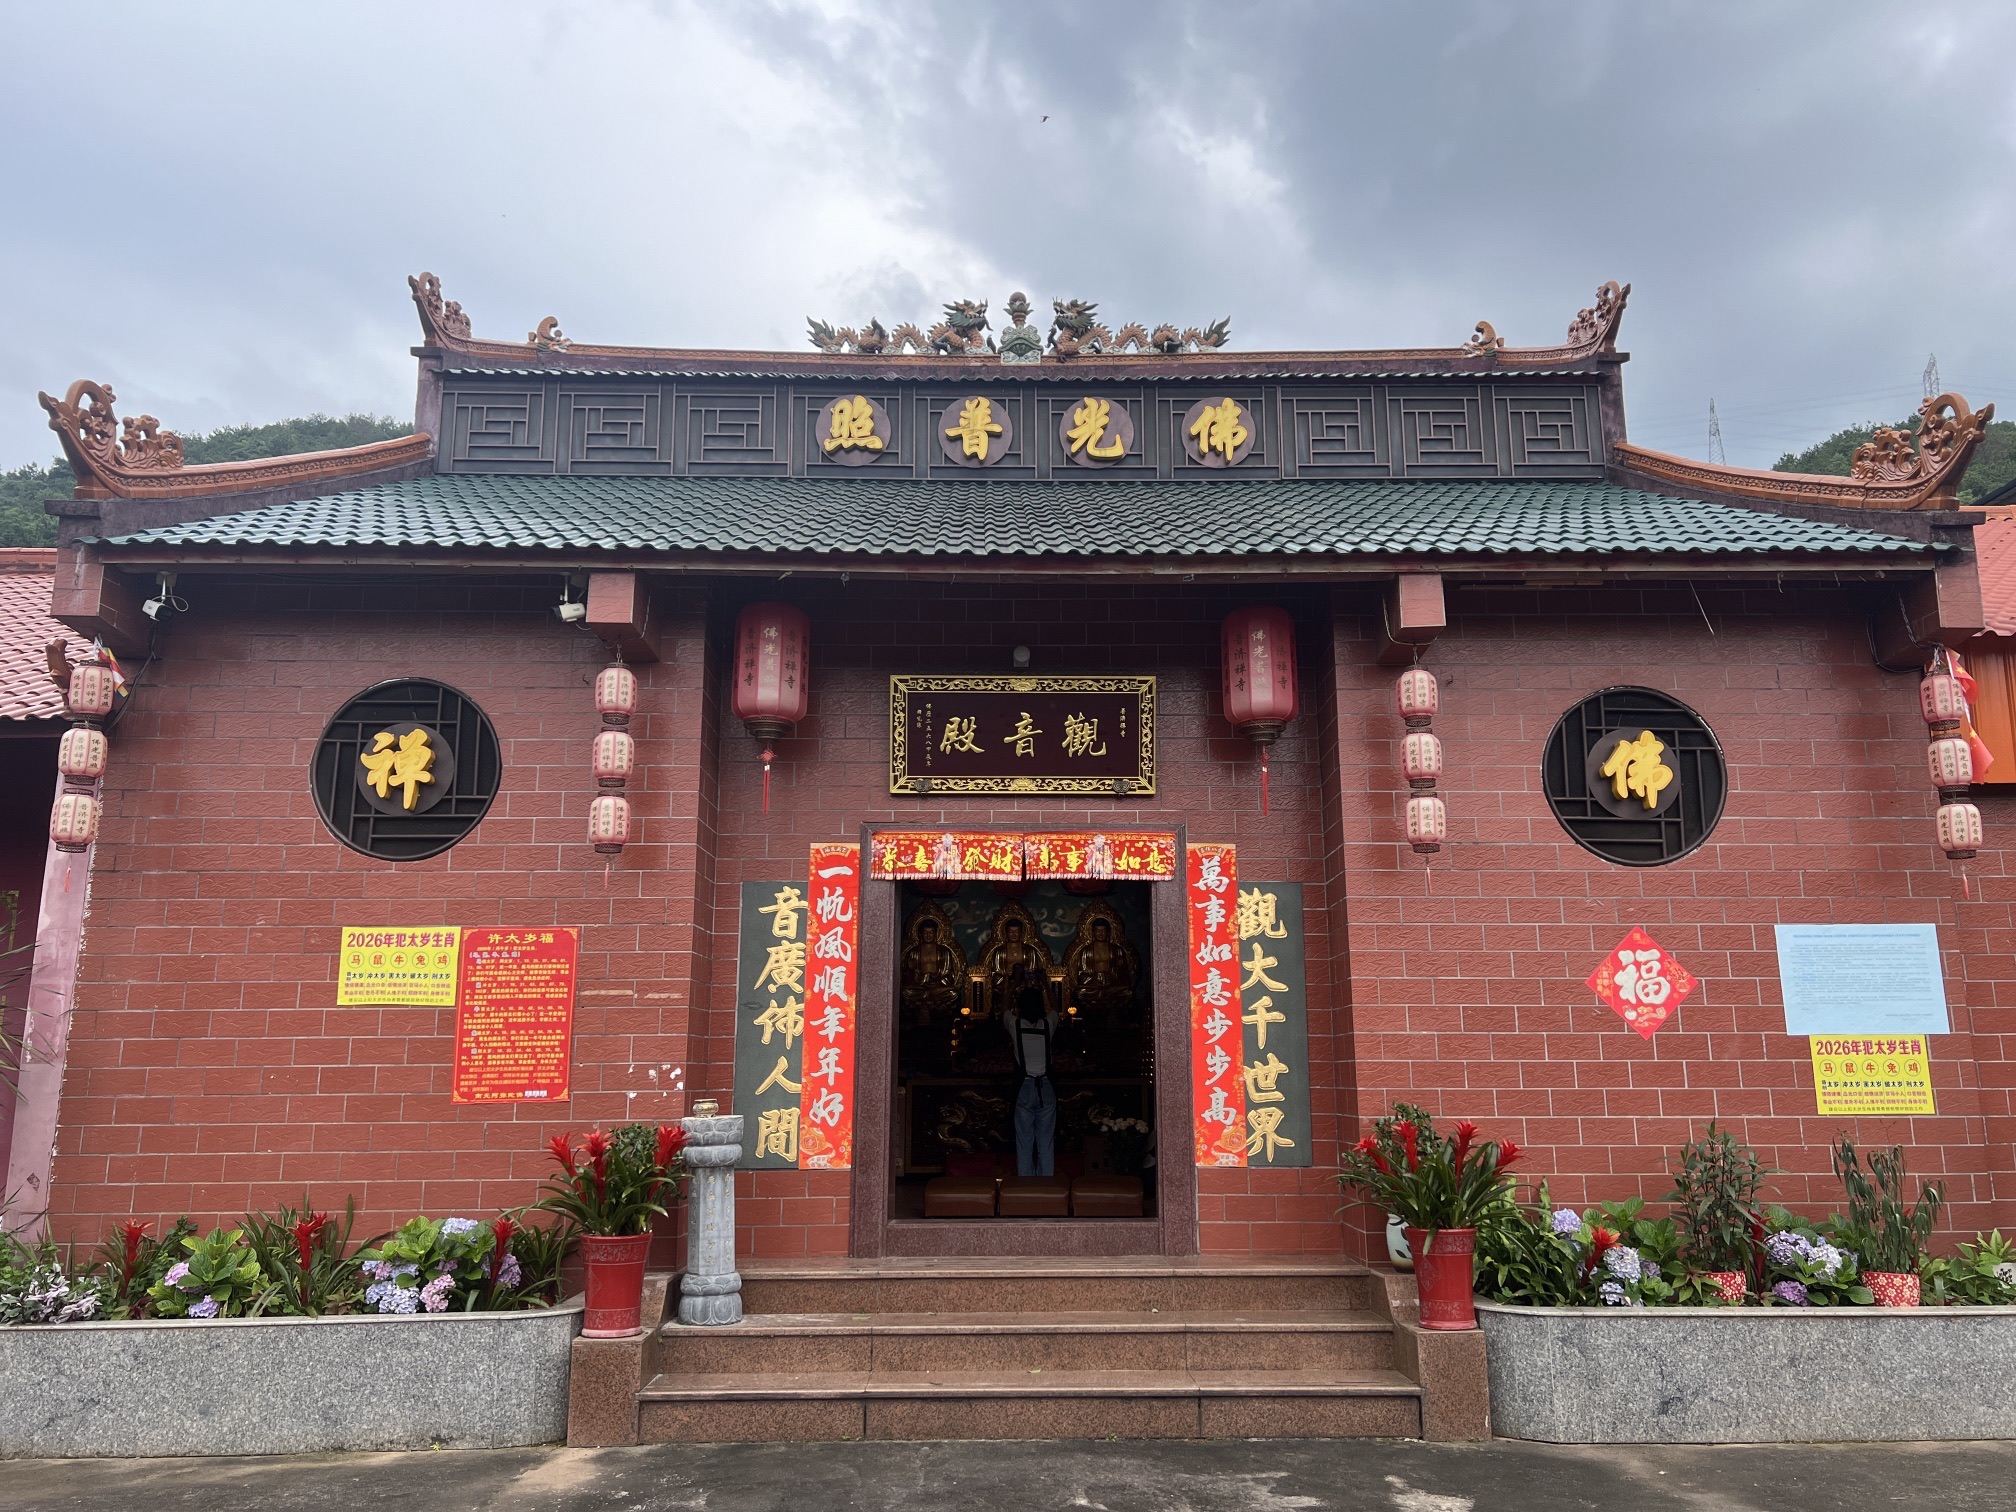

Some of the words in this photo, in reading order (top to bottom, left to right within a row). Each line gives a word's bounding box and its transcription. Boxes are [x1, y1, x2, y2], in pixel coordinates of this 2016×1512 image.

[939, 711, 1107, 758] 觀音殿
[1598, 730, 1674, 810] 佛
[347, 932, 455, 948] 2026年犯太岁生肖
[351, 954, 360, 965] 马
[394, 954, 404, 965] 牛
[415, 954, 426, 966] 兔
[437, 954, 448, 966] 鸡
[487, 933, 554, 944] 许太岁福
[810, 865, 853, 1127] 一帆風順年年好
[1192, 855, 1237, 1125] 萬事如意步步高
[1614, 948, 1671, 1005] 福
[1237, 887, 1295, 1163] 觀大千世界
[1816, 1039, 1922, 1056] 2026年犯太岁生肖
[1823, 1063, 1833, 1073] 马
[1866, 1062, 1875, 1073] 牛
[1887, 1062, 1897, 1074] 兔
[1908, 1062, 1919, 1074] 鸡
